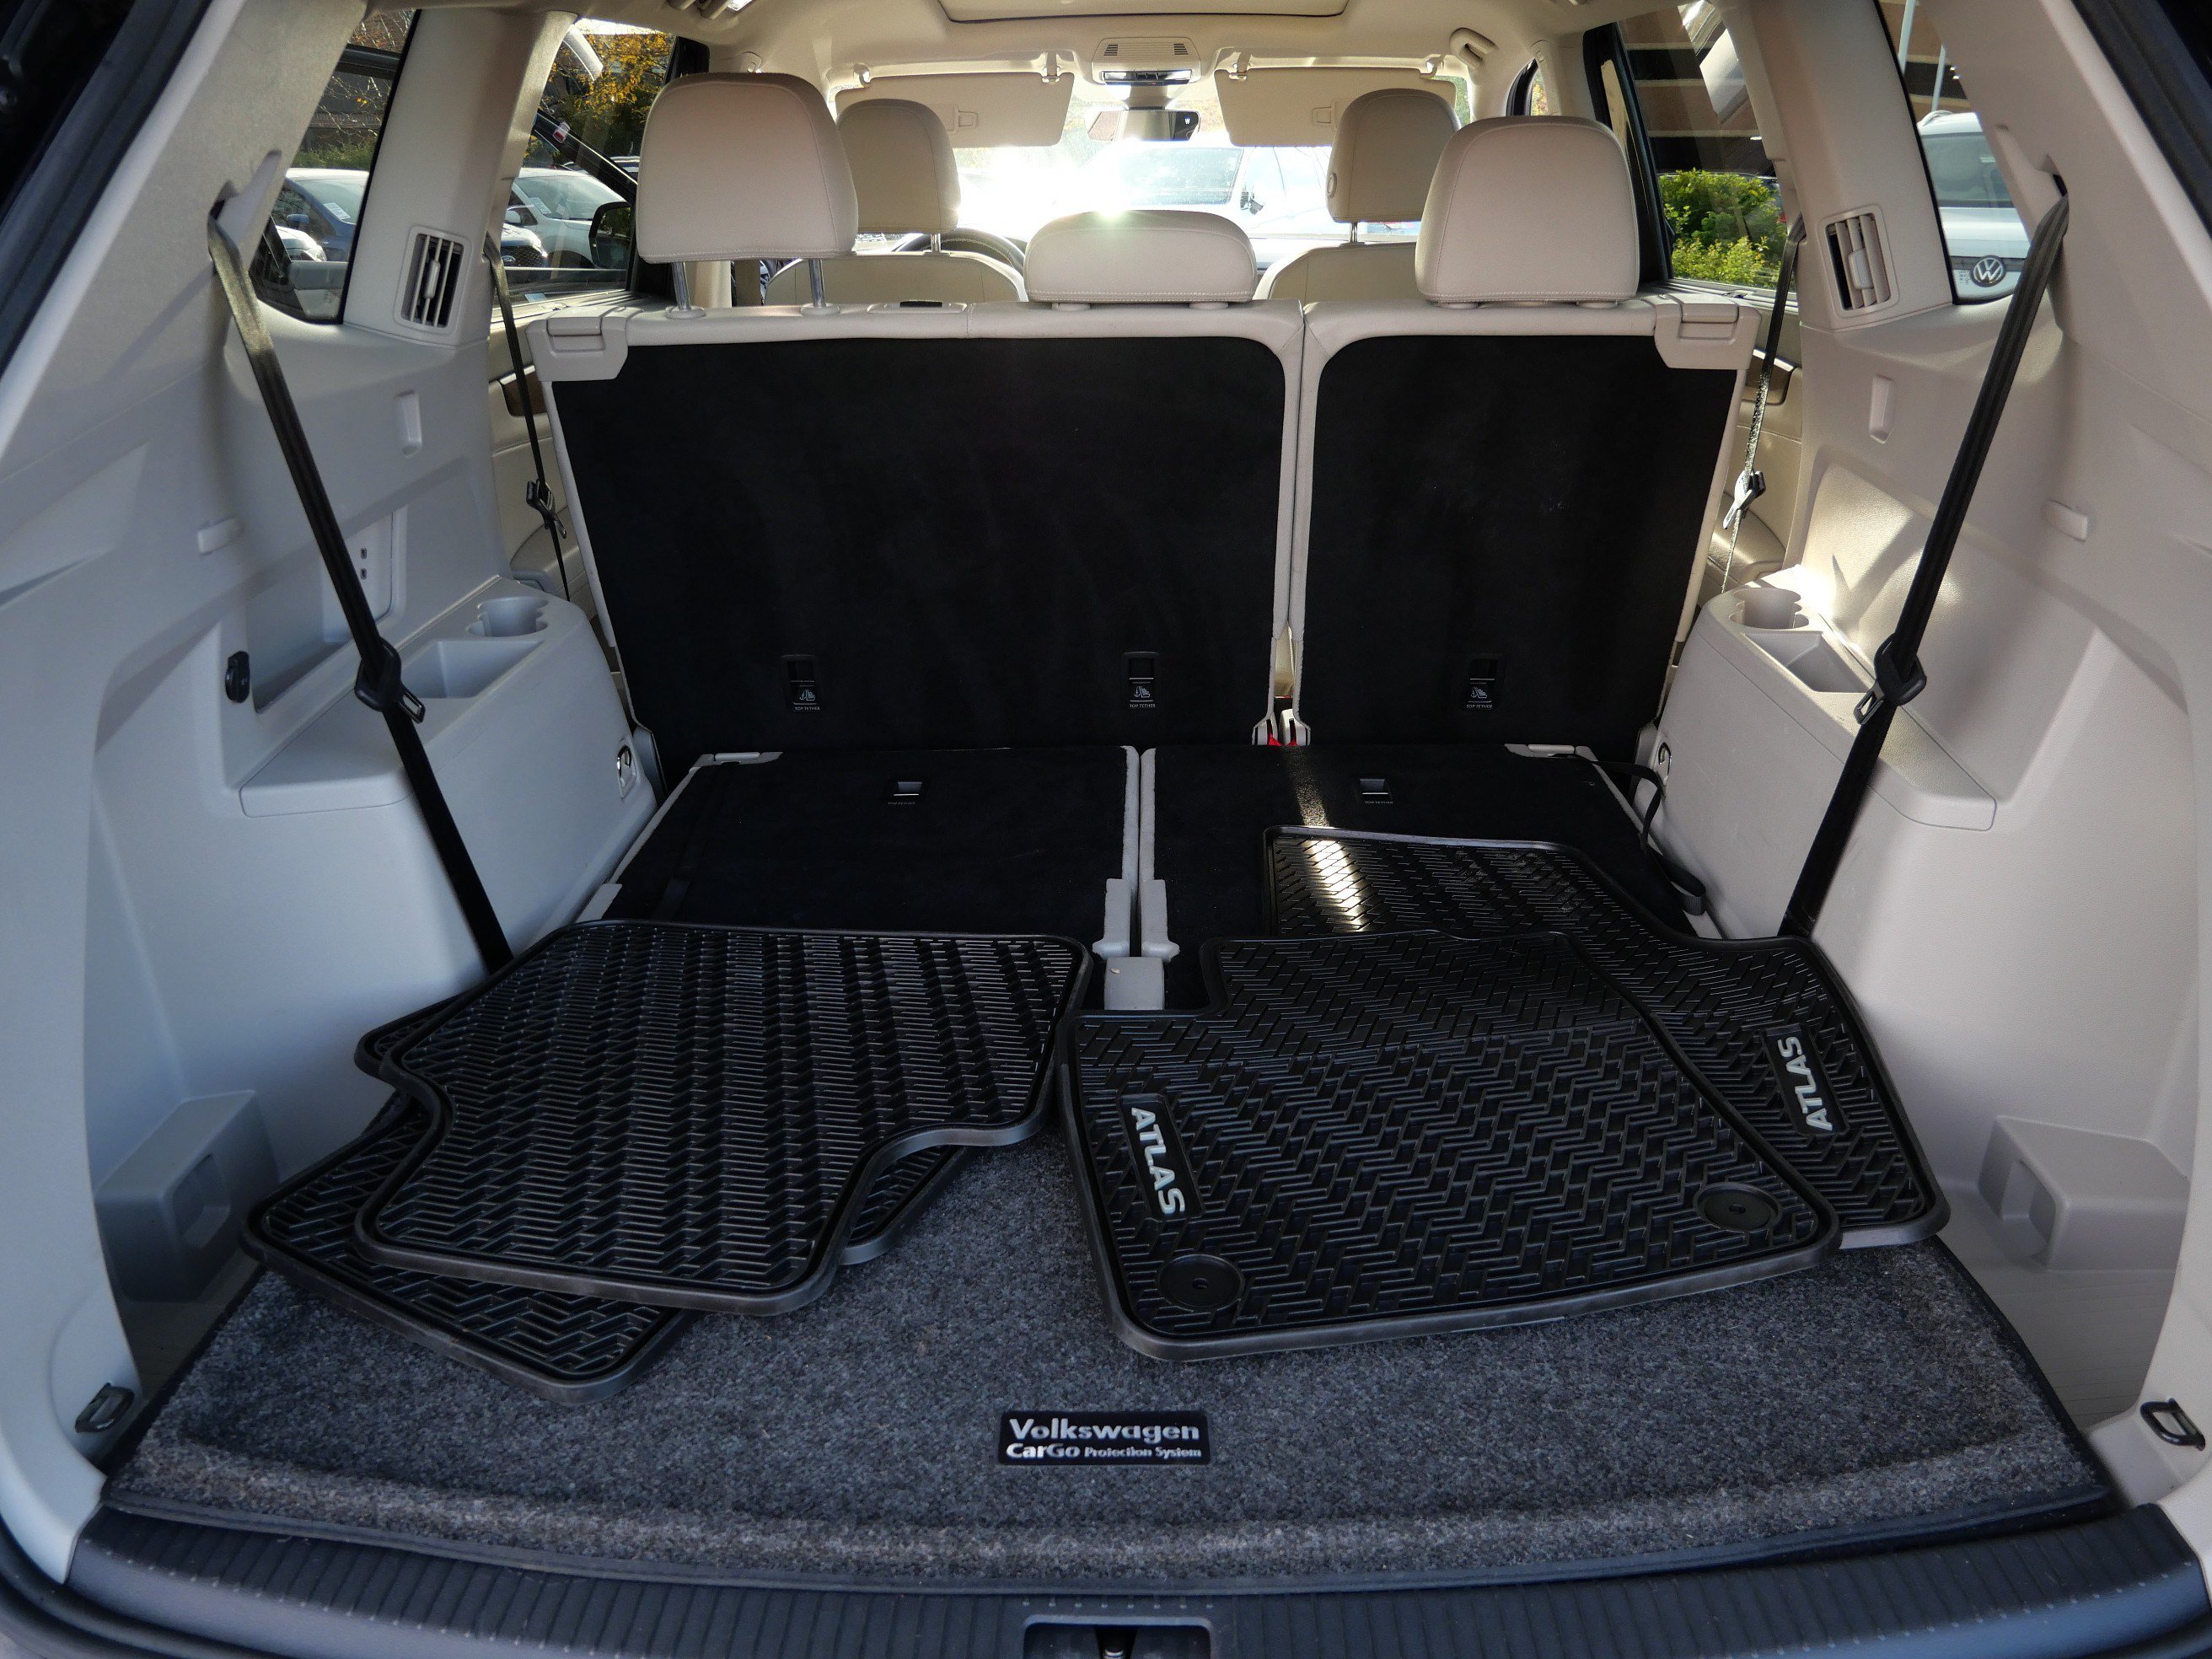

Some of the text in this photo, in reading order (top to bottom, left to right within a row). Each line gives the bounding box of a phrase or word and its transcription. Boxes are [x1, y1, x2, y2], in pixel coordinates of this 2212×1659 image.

[1777, 1036, 1833, 1131] ATLAS
[1130, 1107, 1186, 1215] ATLAS
[1006, 1442, 1202, 1459] CarGo Protection System
[1009, 1417, 1200, 1445] Volkswagen
